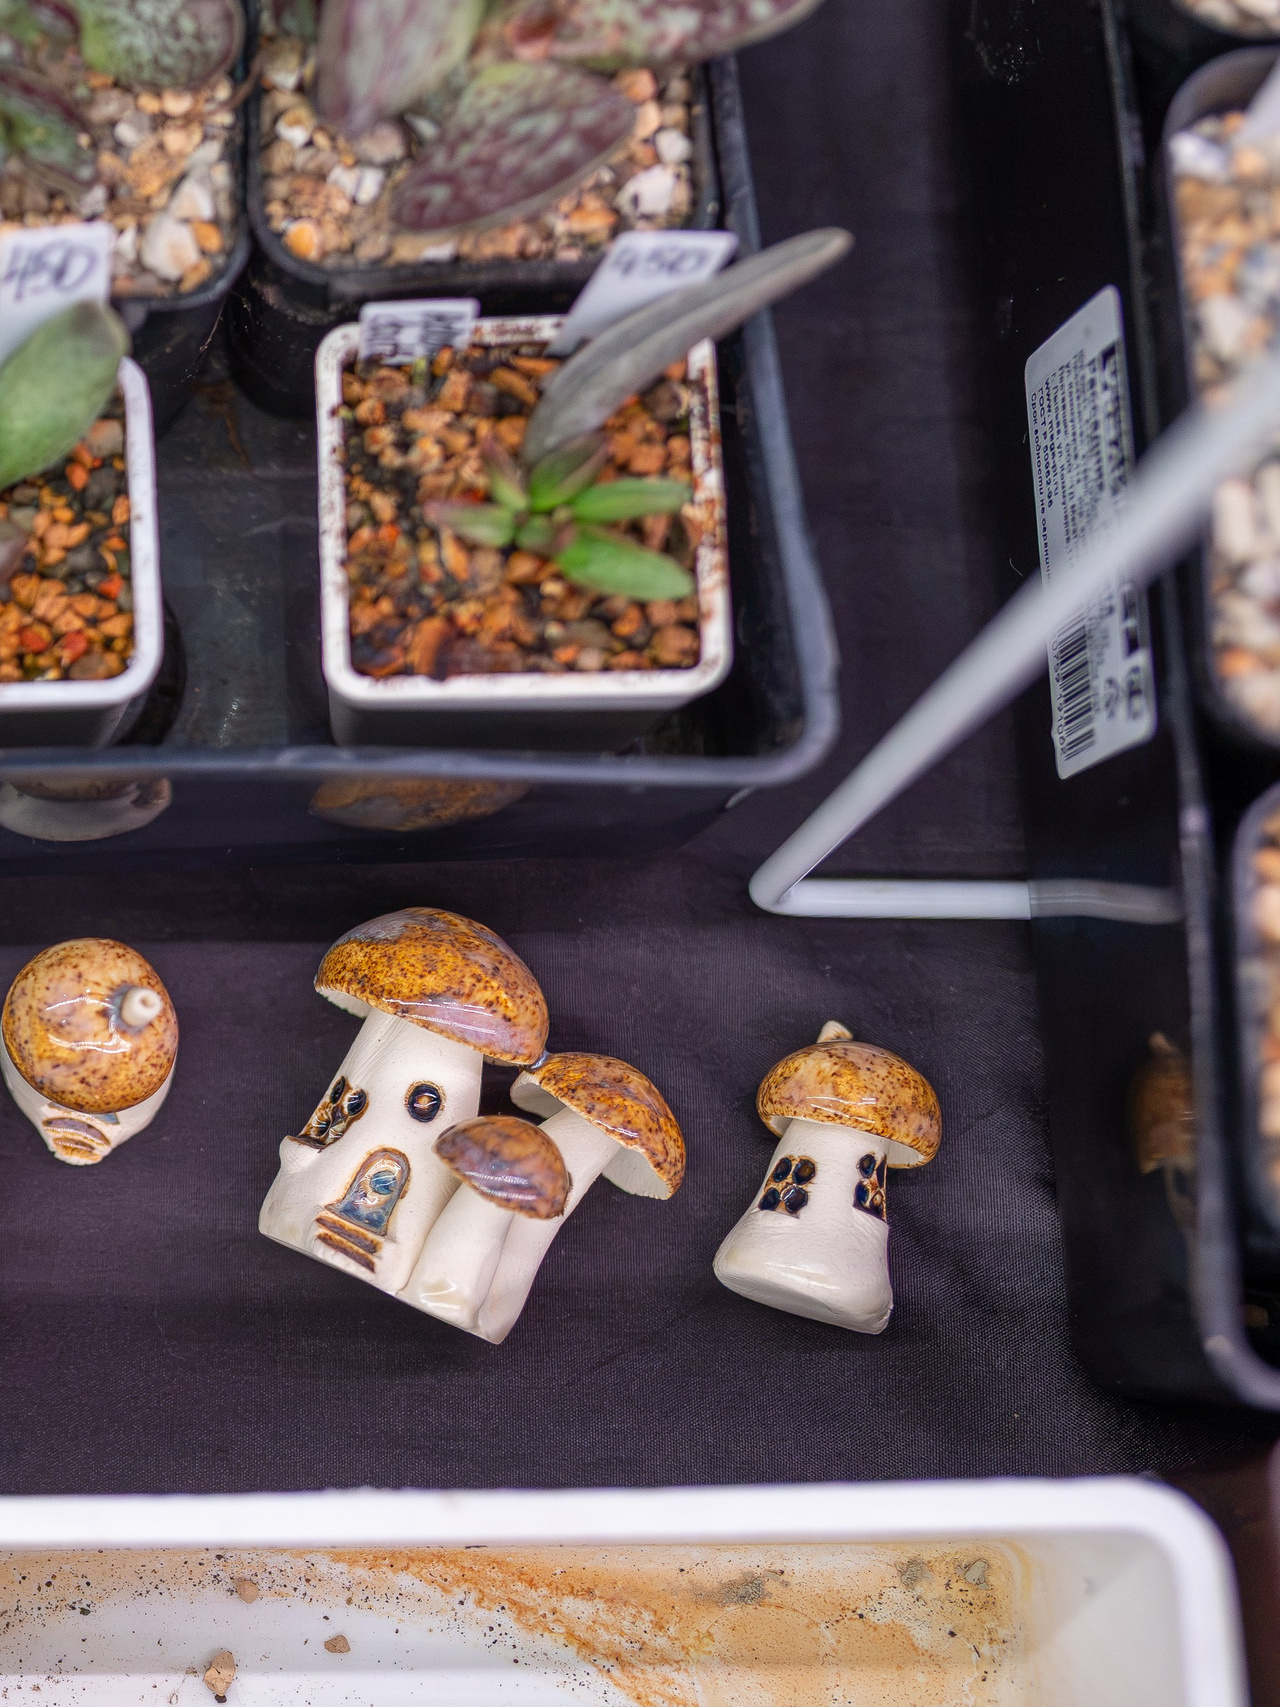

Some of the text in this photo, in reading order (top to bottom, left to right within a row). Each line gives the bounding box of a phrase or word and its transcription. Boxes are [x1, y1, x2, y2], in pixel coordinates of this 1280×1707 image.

[610, 243, 710, 275] 450
[1030, 390, 1039, 427] Срок
[1037, 386, 1046, 429] ГОСТ
